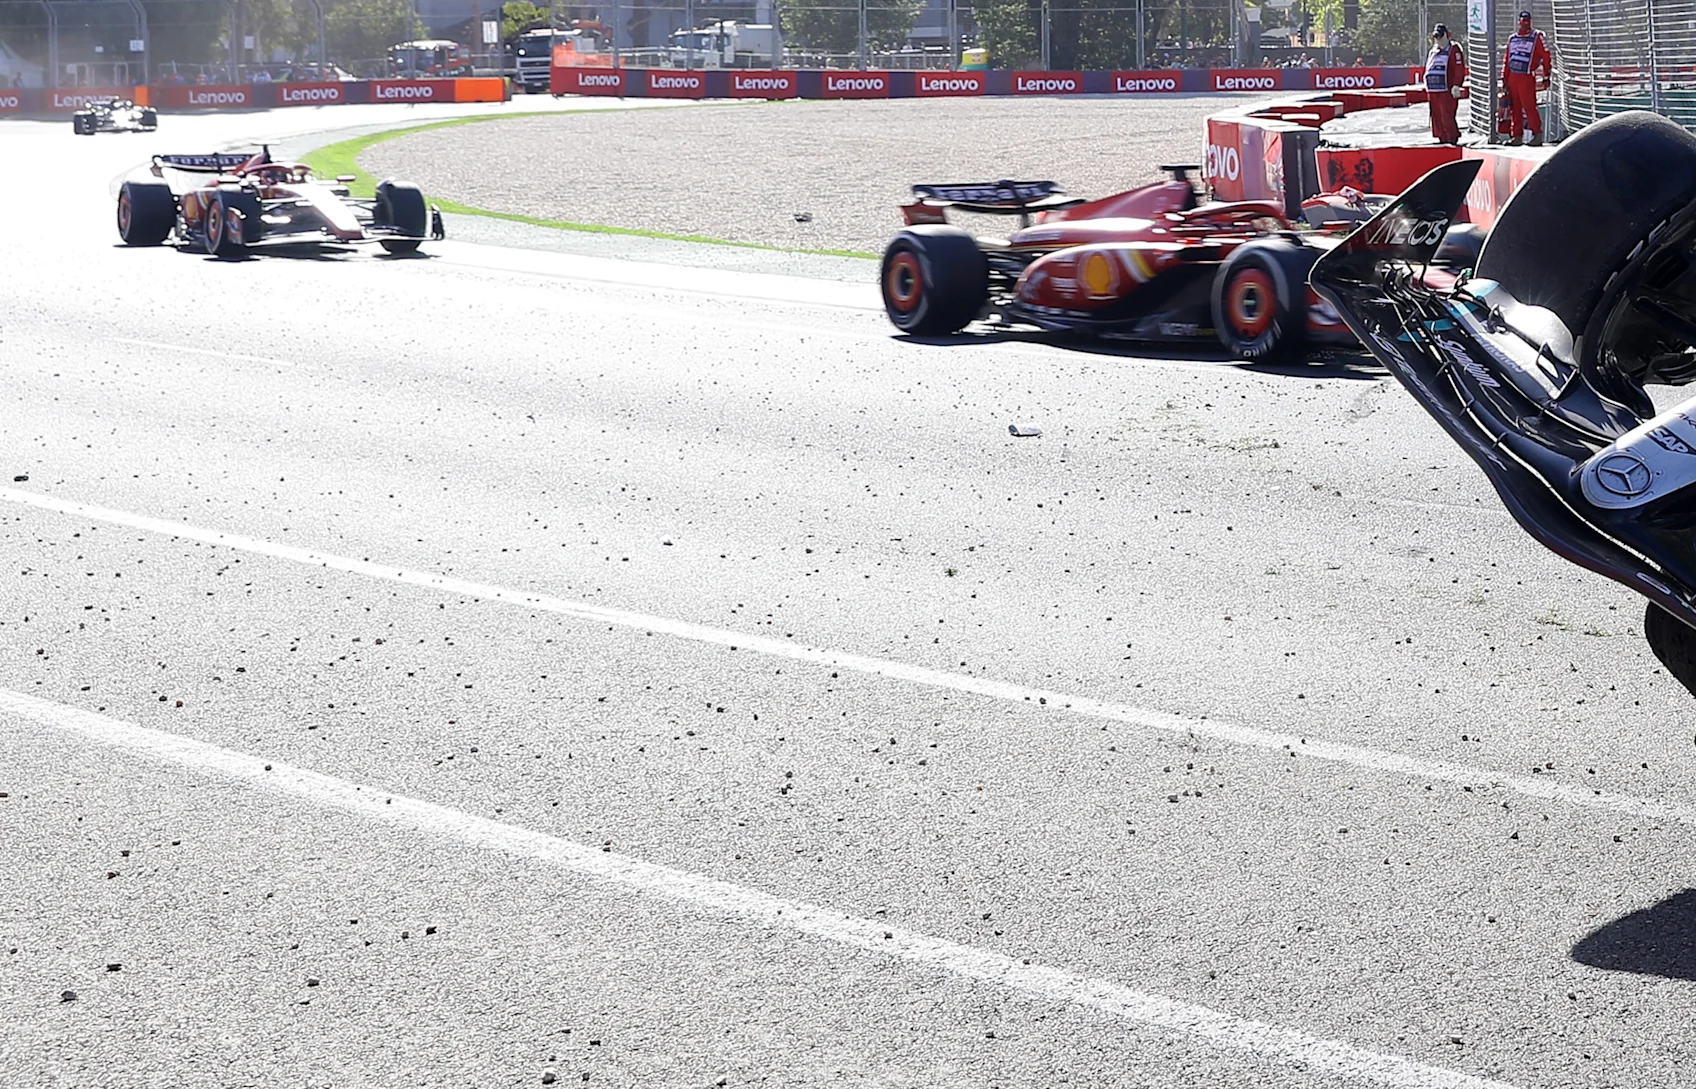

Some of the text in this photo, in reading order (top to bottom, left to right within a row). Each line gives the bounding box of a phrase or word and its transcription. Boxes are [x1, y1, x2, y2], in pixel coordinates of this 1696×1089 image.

[578, 72, 620, 88] Lenovo
[651, 74, 699, 89] Lenovo
[735, 76, 789, 90] Lenovo
[828, 76, 884, 91] Lenovo
[921, 77, 979, 91] Lenovo
[1017, 77, 1076, 91] Lenovo
[1117, 76, 1175, 91] Lenovo
[1216, 75, 1275, 90] Lenovo
[1315, 73, 1375, 88] Lenovo
[189, 90, 245, 104] Lenovo
[283, 88, 338, 101] Lenovo
[376, 85, 433, 98] Lenovo
[1651, 428, 1690, 453] SAP
